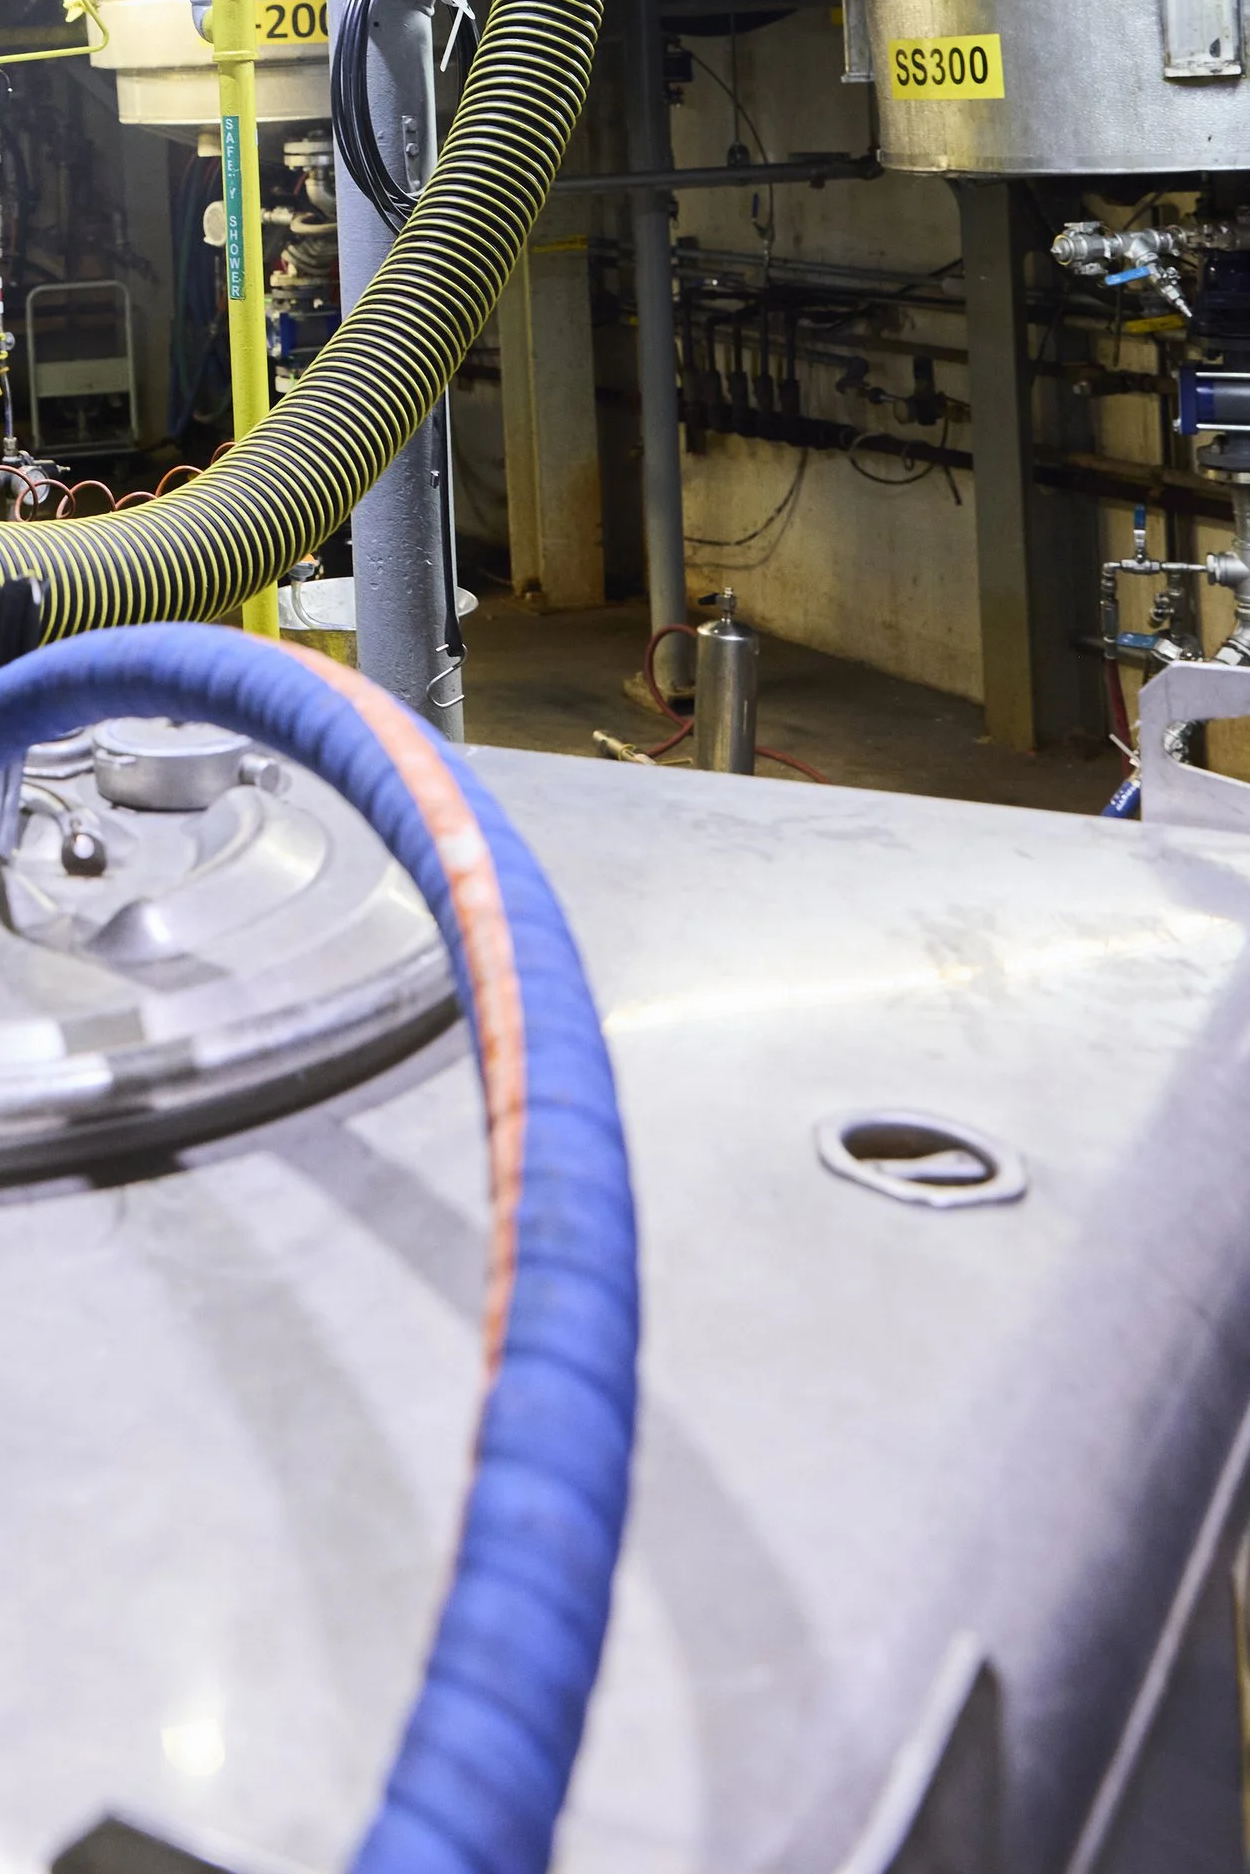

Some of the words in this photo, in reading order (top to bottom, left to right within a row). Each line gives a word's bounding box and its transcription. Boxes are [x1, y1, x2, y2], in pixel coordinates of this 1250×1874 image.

[896, 46, 988, 86] SS300
[225, 118, 237, 199] SAFEY
[229, 215, 242, 298] SHOWER
